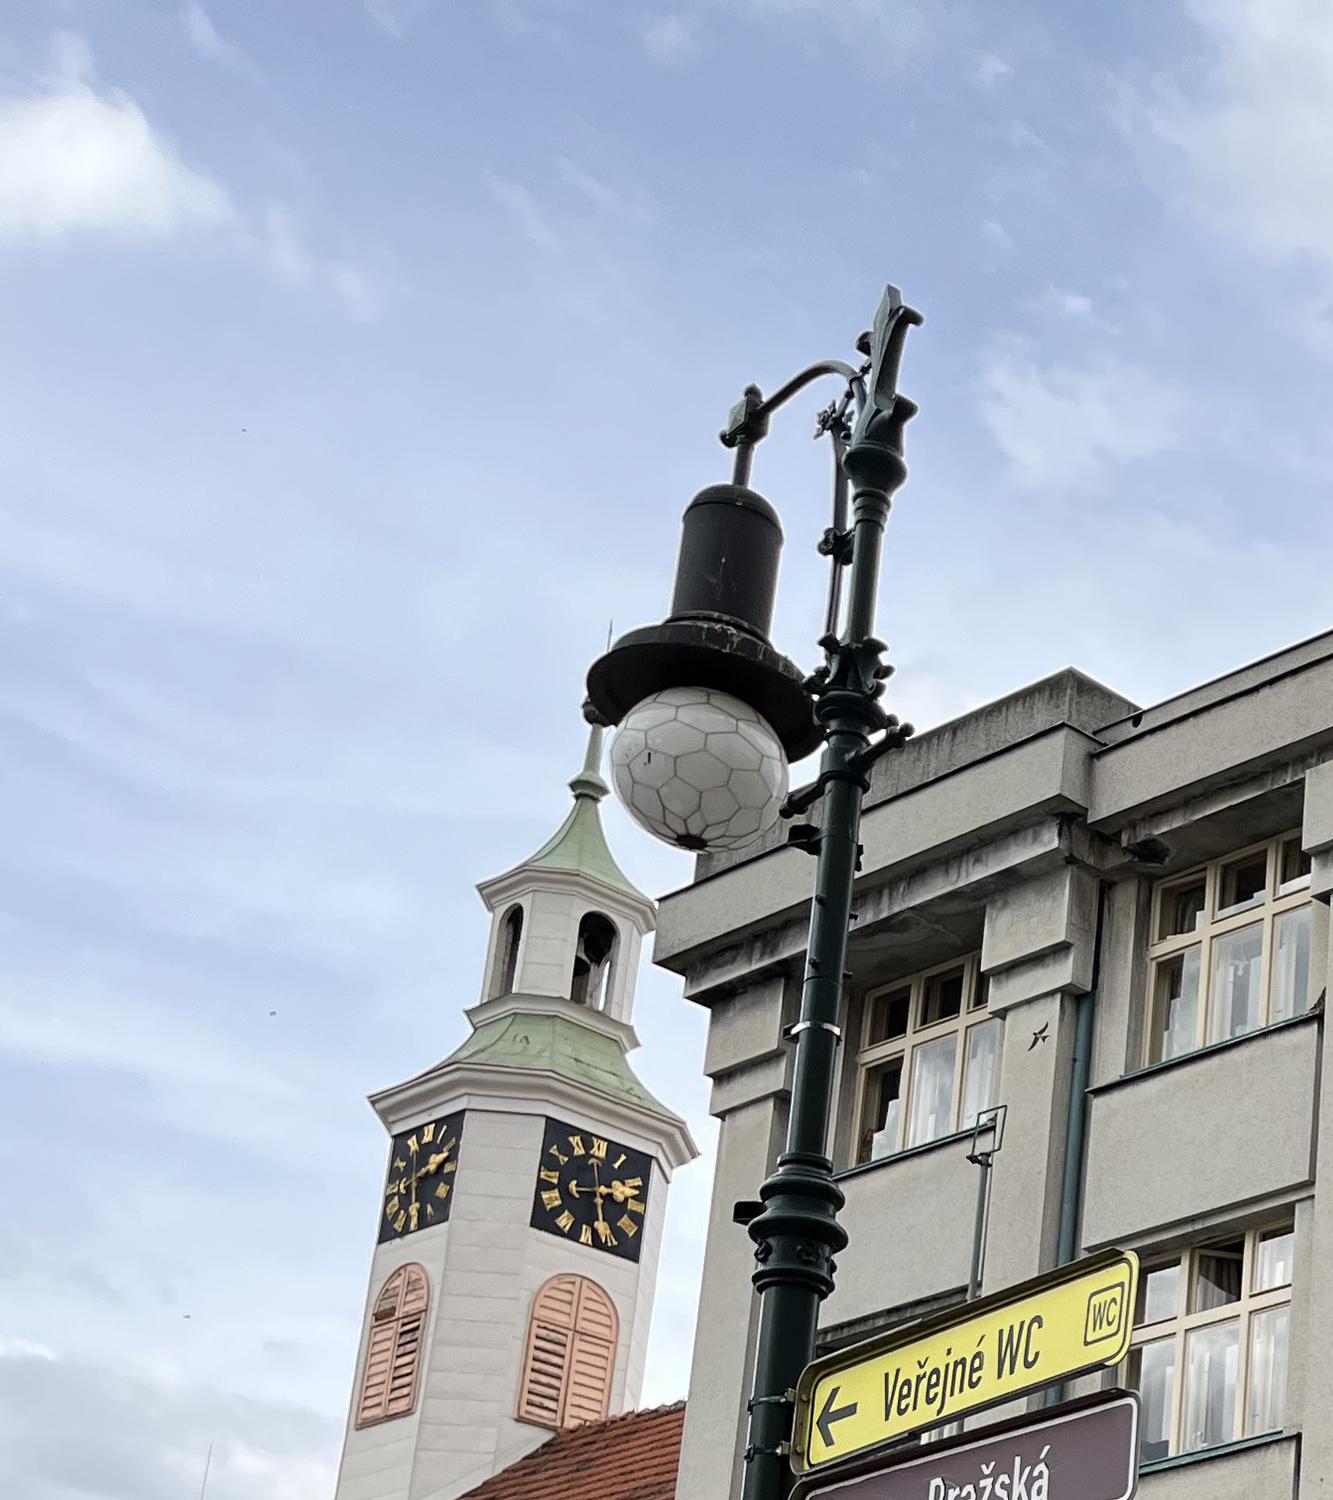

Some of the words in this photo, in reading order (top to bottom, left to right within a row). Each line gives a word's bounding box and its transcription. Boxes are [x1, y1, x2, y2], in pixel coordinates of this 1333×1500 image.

[1091, 1296, 1118, 1333] WC
[883, 1334, 986, 1421] Veřejné
[996, 1314, 1043, 1380] WC
